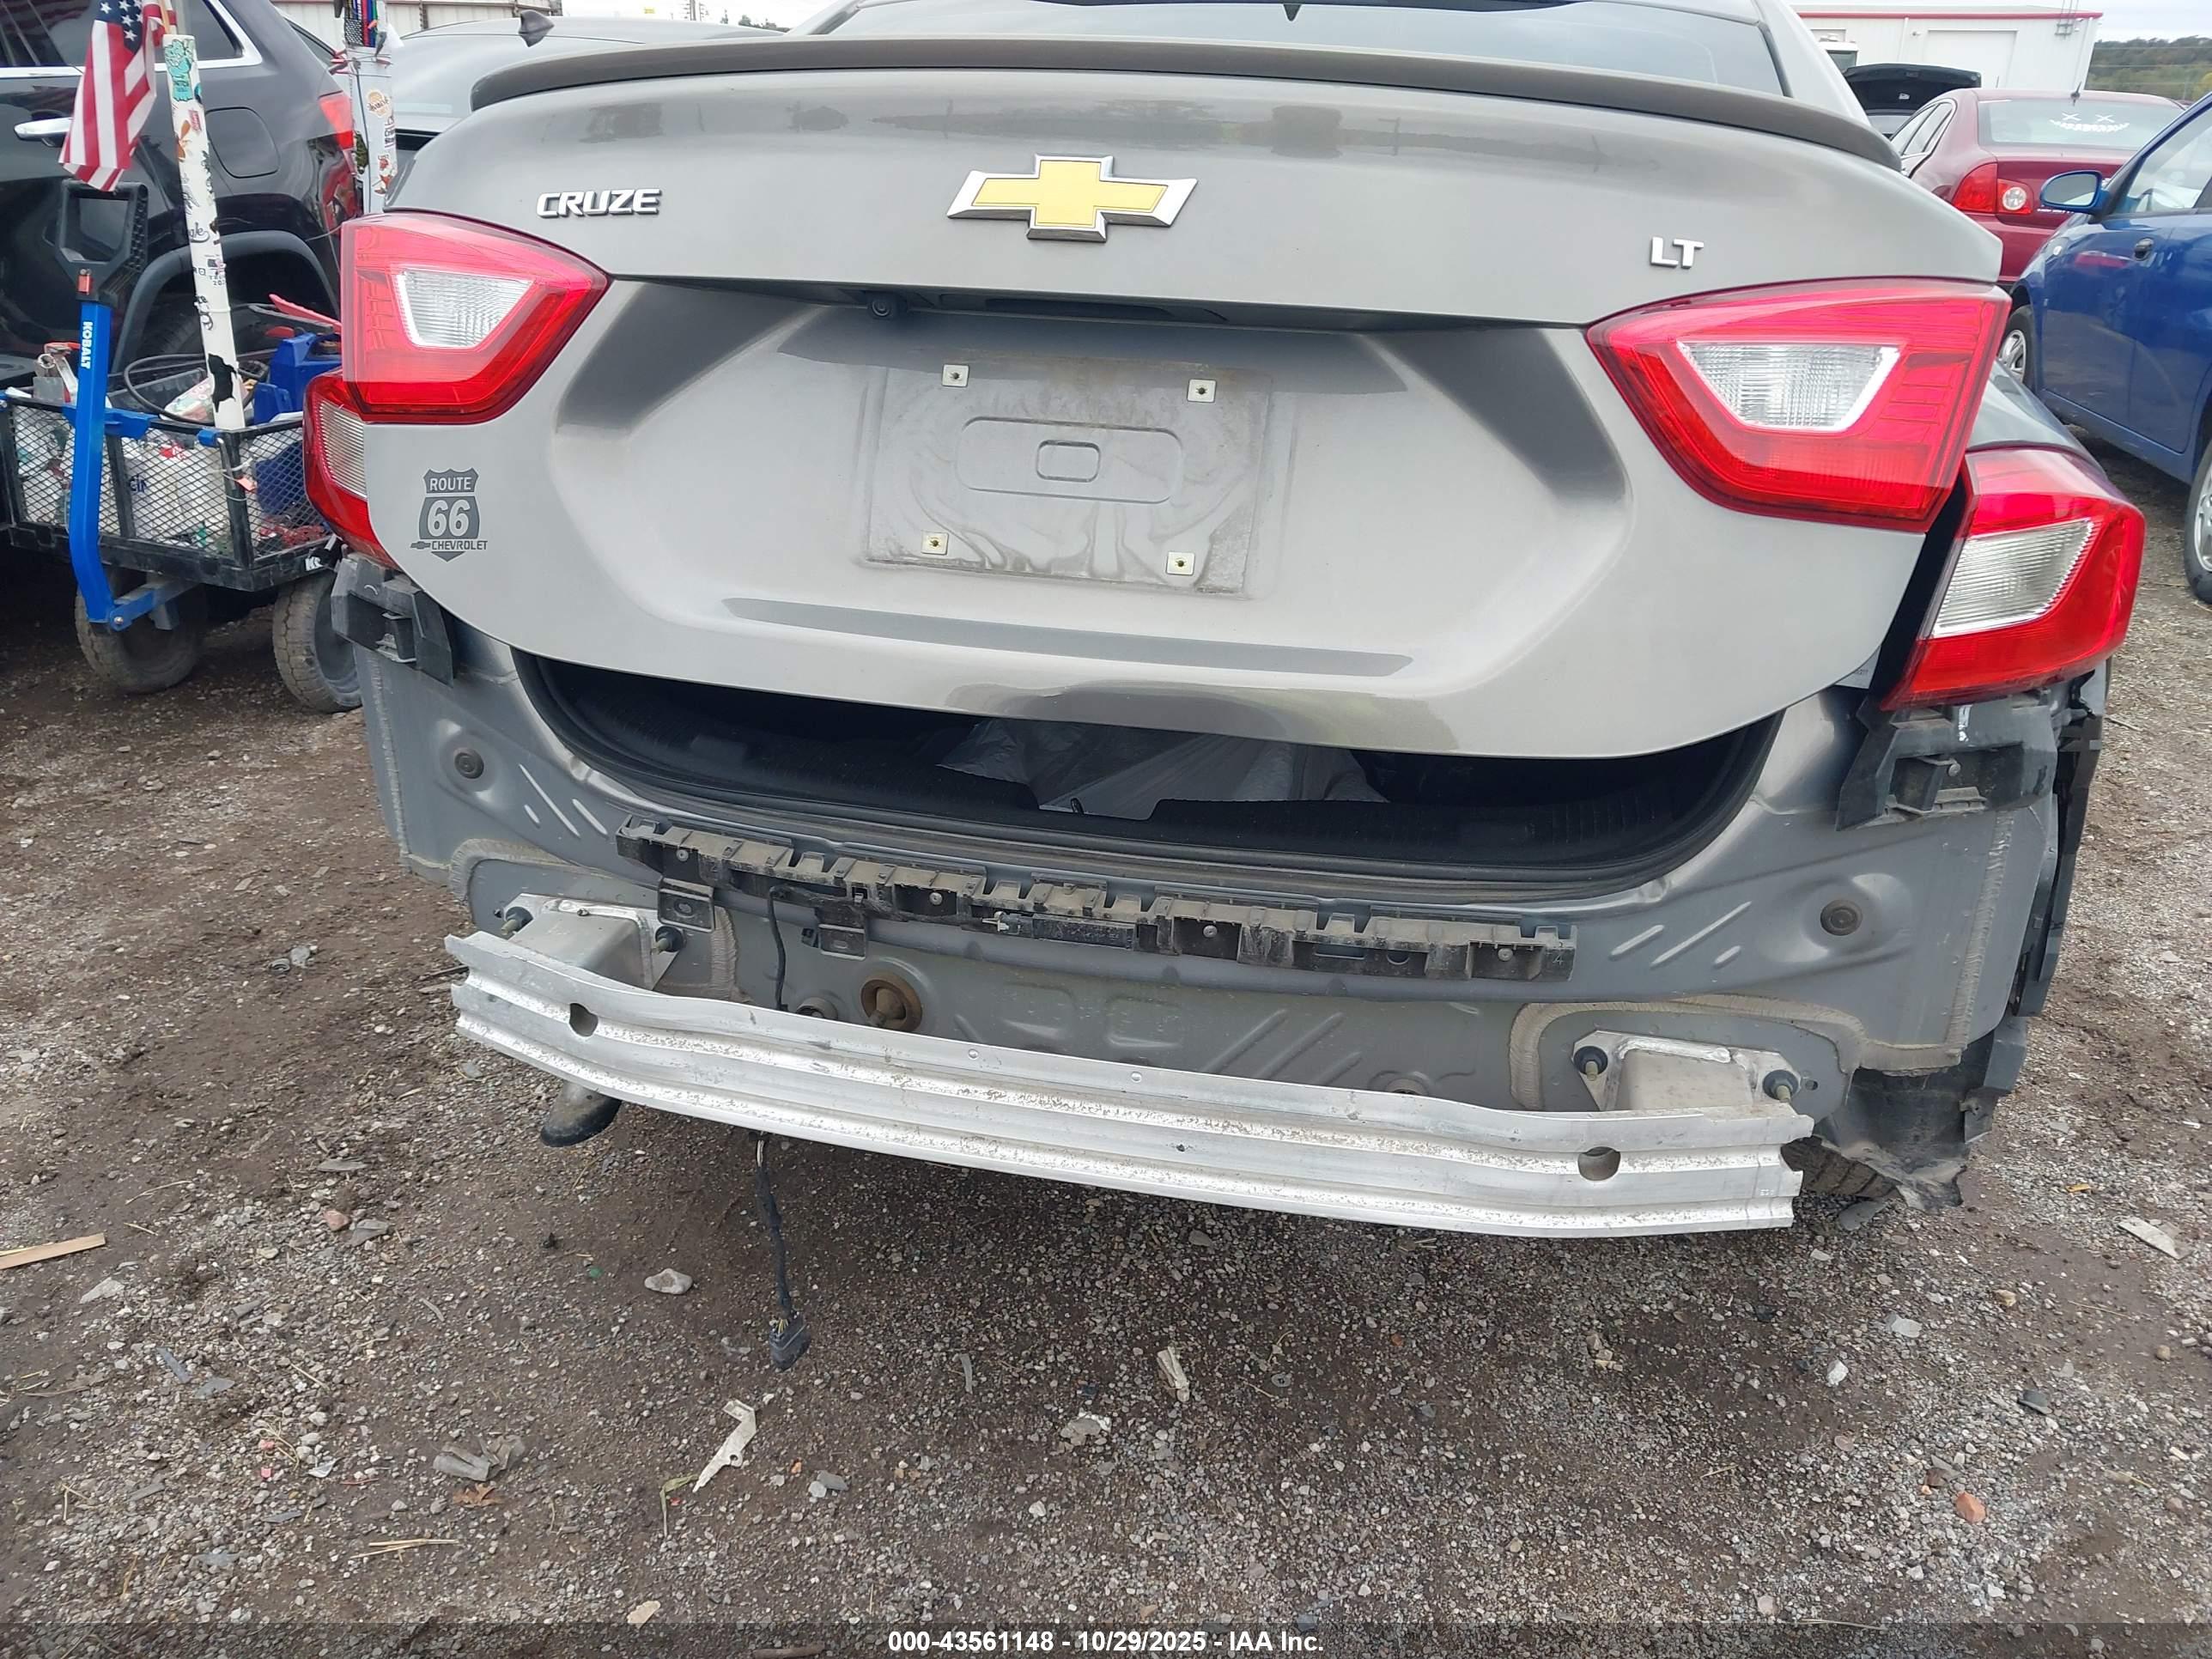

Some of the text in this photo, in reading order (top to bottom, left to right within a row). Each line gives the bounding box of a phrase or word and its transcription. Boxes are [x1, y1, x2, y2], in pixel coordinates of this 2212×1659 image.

[537, 188, 662, 218] CRUZE
[1650, 236, 1704, 270] LT
[81, 321, 93, 369] KOBALT
[429, 477, 471, 491] ROUTE
[427, 499, 471, 537] 66
[432, 540, 488, 550] CHEVROLET
